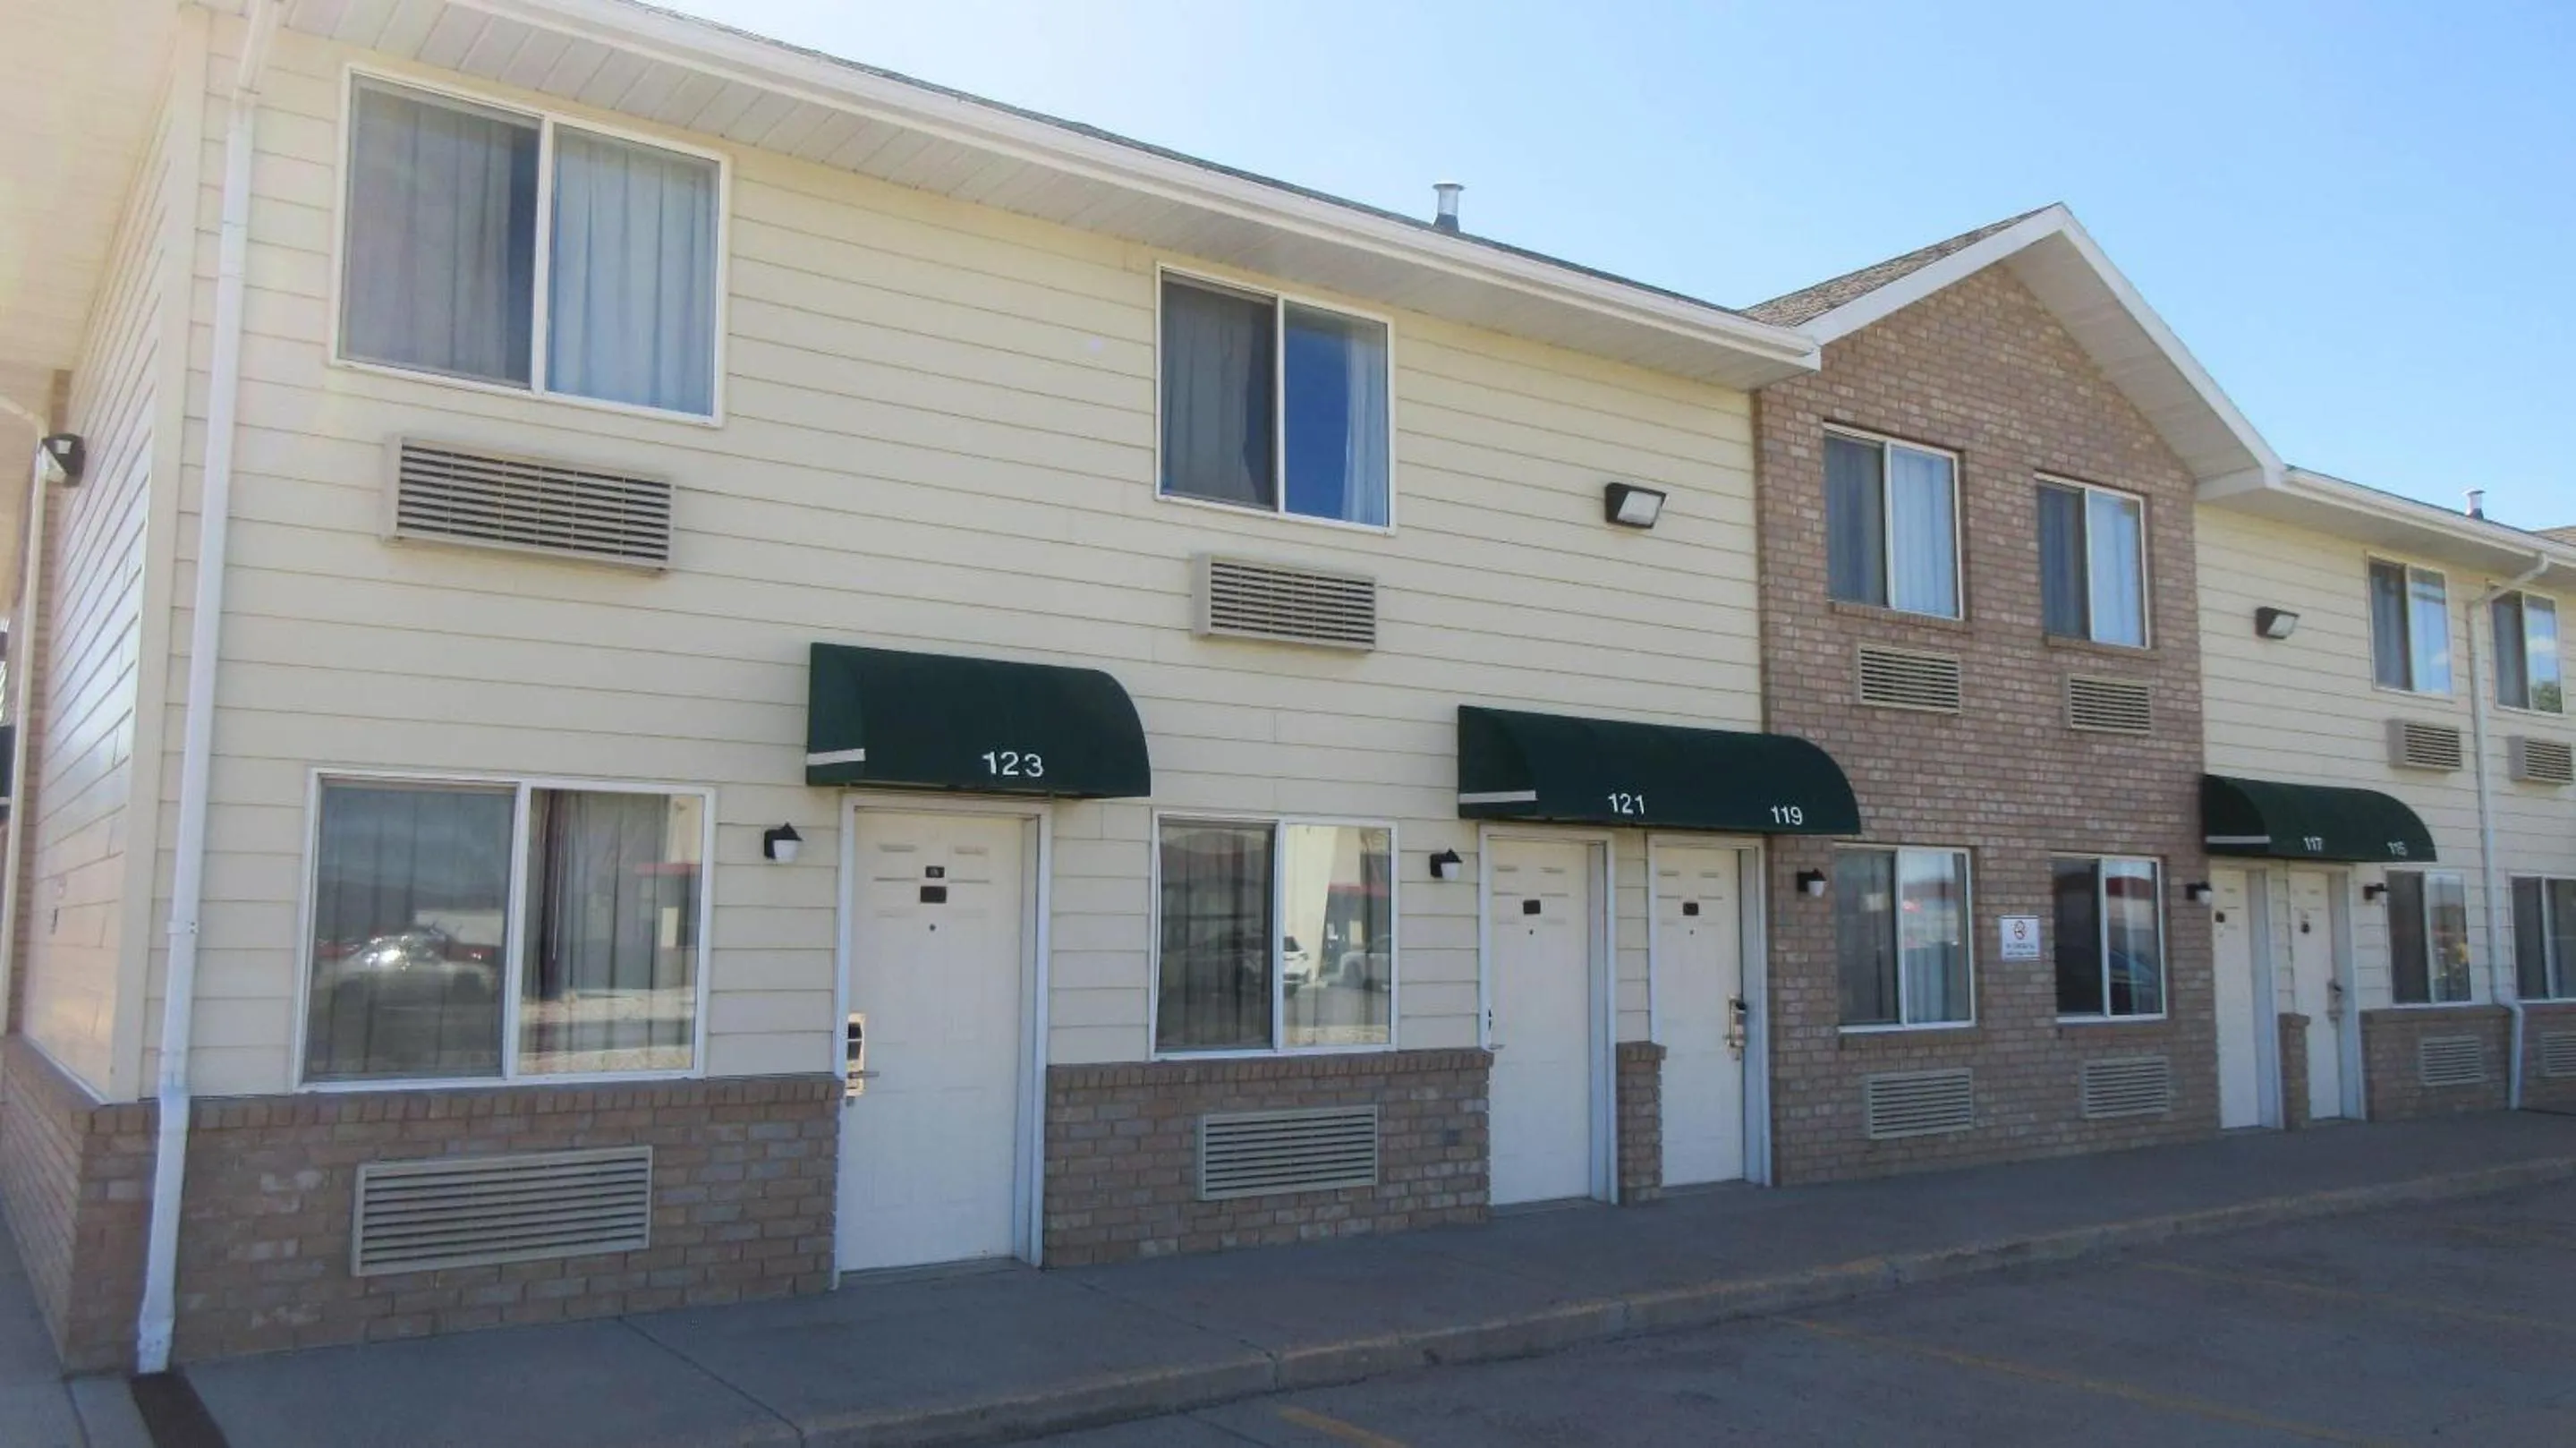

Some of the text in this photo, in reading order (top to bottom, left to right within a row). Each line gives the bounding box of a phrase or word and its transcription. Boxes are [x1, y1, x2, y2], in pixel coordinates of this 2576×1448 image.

[982, 751, 1044, 778] 123
[1608, 793, 1645, 814] 121
[1771, 805, 1803, 825] 119
[2303, 836, 2323, 851] 117
